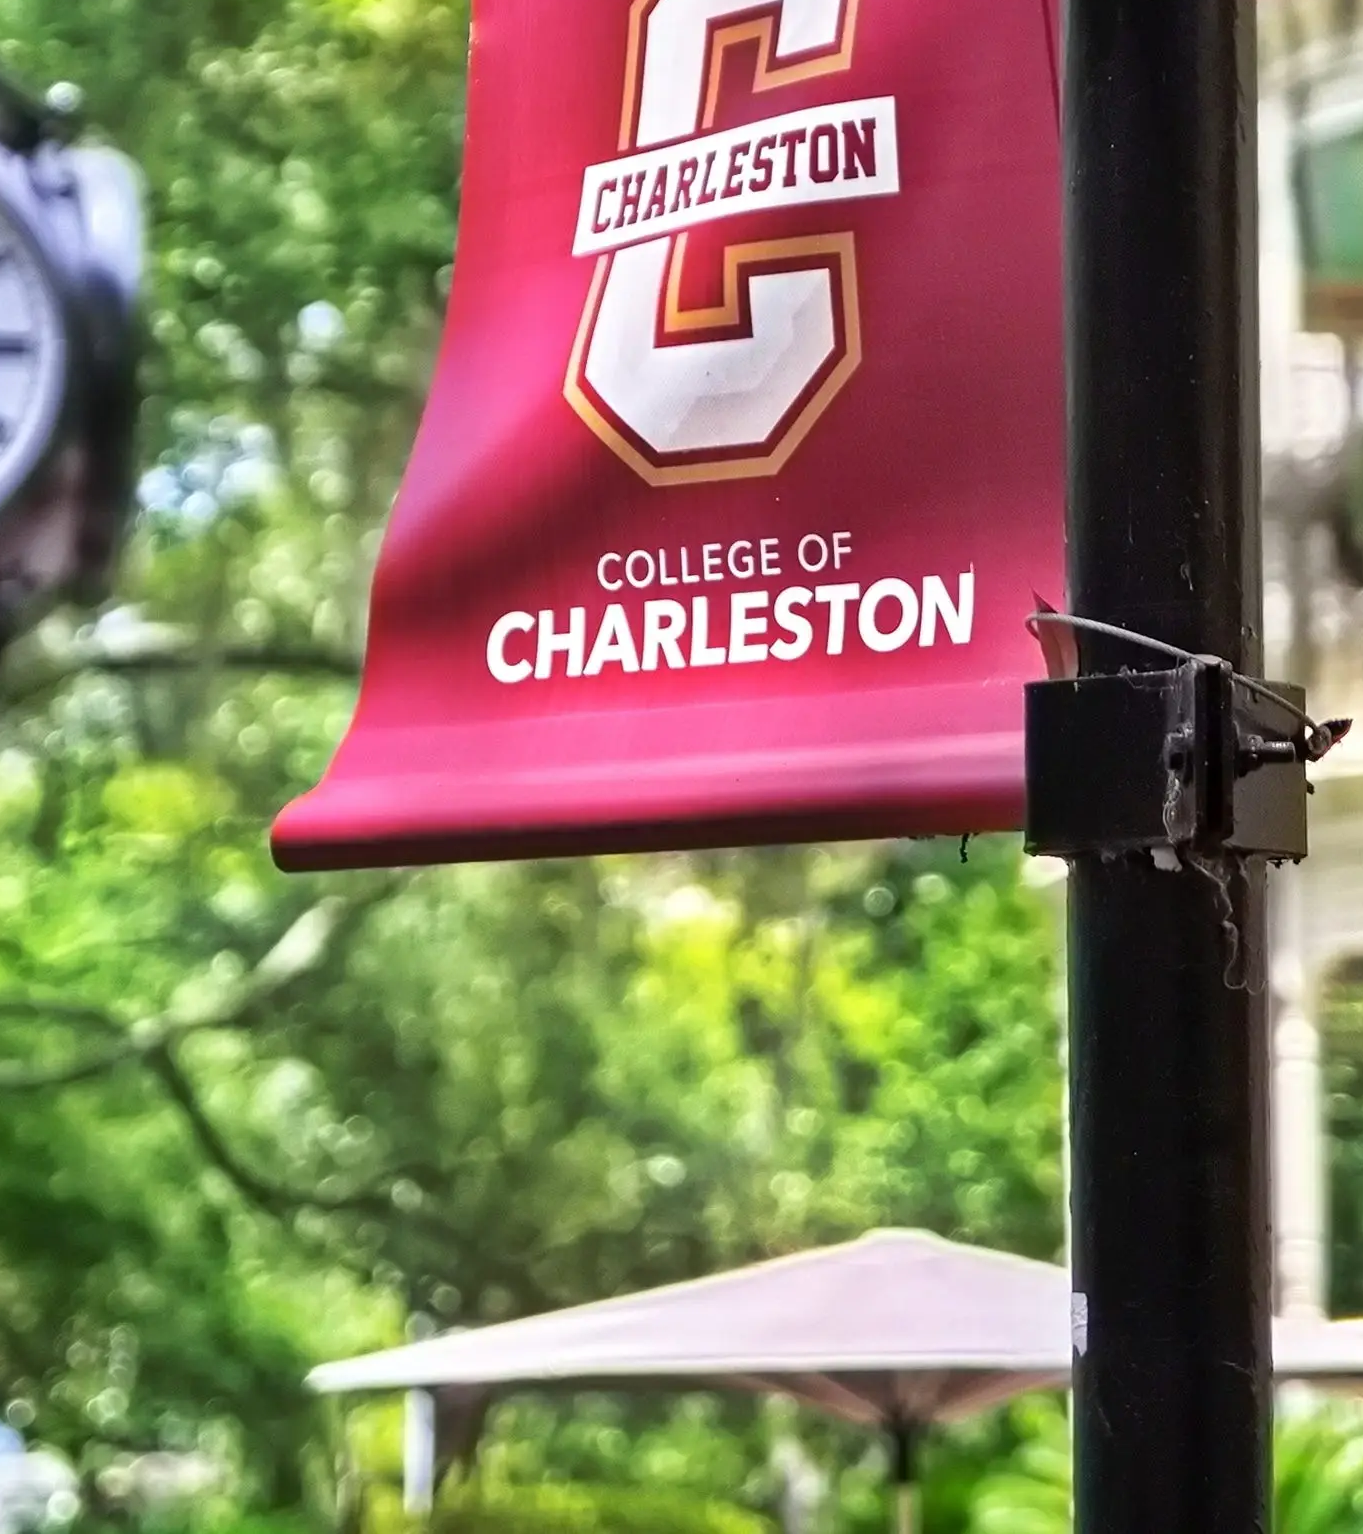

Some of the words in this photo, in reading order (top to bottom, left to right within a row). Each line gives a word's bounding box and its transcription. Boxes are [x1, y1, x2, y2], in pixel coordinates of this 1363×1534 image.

[590, 117, 877, 234] CHARLESTON
[597, 537, 780, 591] COLLEGE
[797, 531, 852, 573] OF
[486, 571, 974, 684] CHARLESTON
